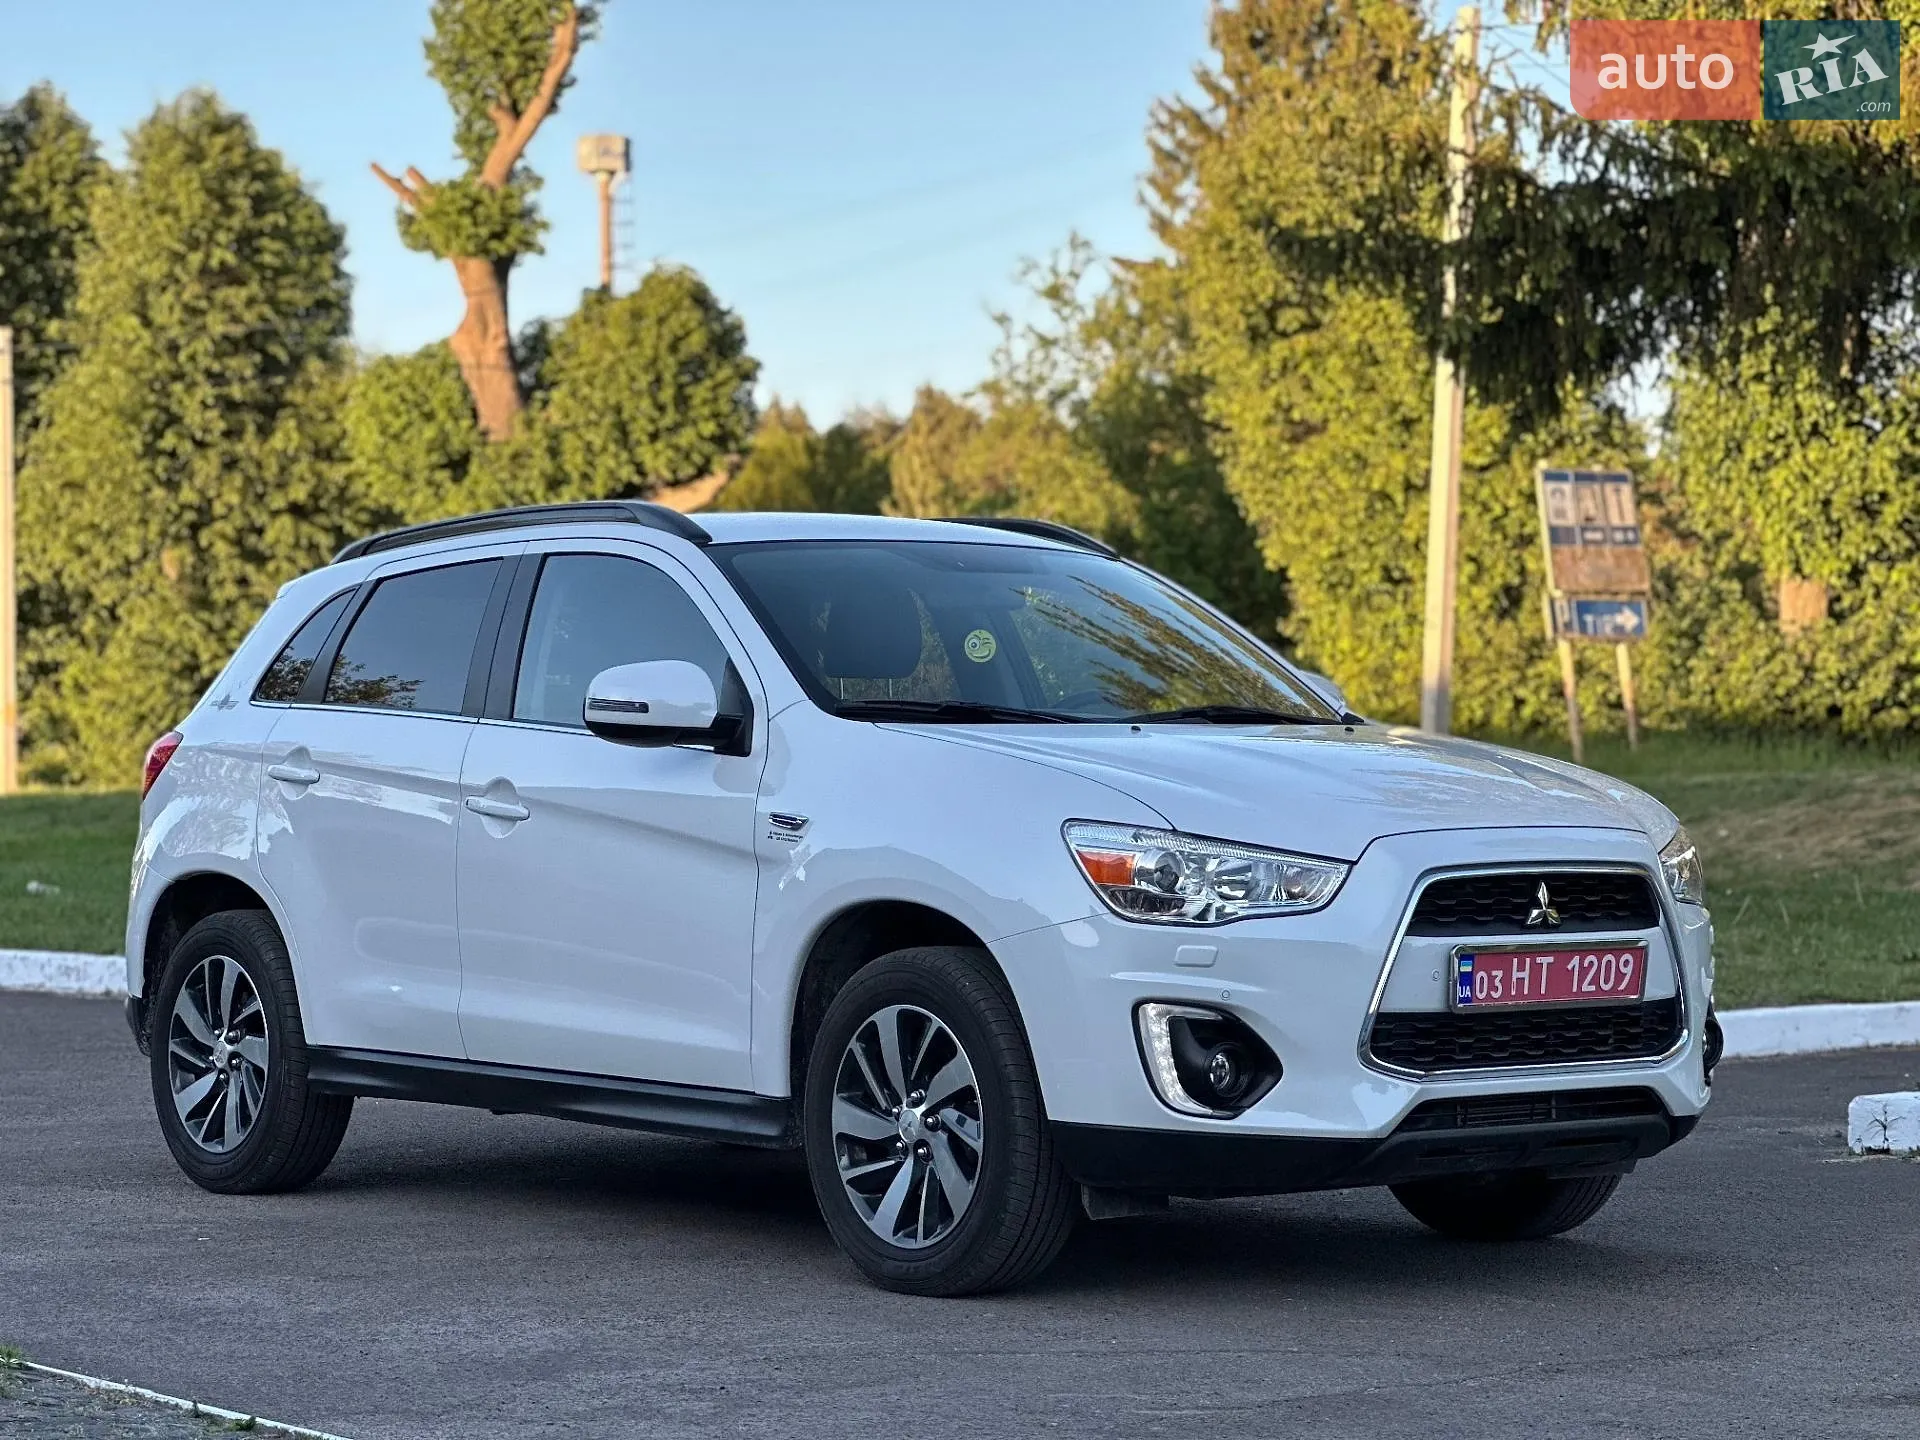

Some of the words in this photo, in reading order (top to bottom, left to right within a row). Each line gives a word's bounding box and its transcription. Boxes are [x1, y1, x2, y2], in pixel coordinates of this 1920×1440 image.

[1475, 970, 1503, 999] 03
[1511, 956, 1554, 995] HT
[1567, 953, 1634, 992] 1209
[1458, 986, 1471, 998] UA
